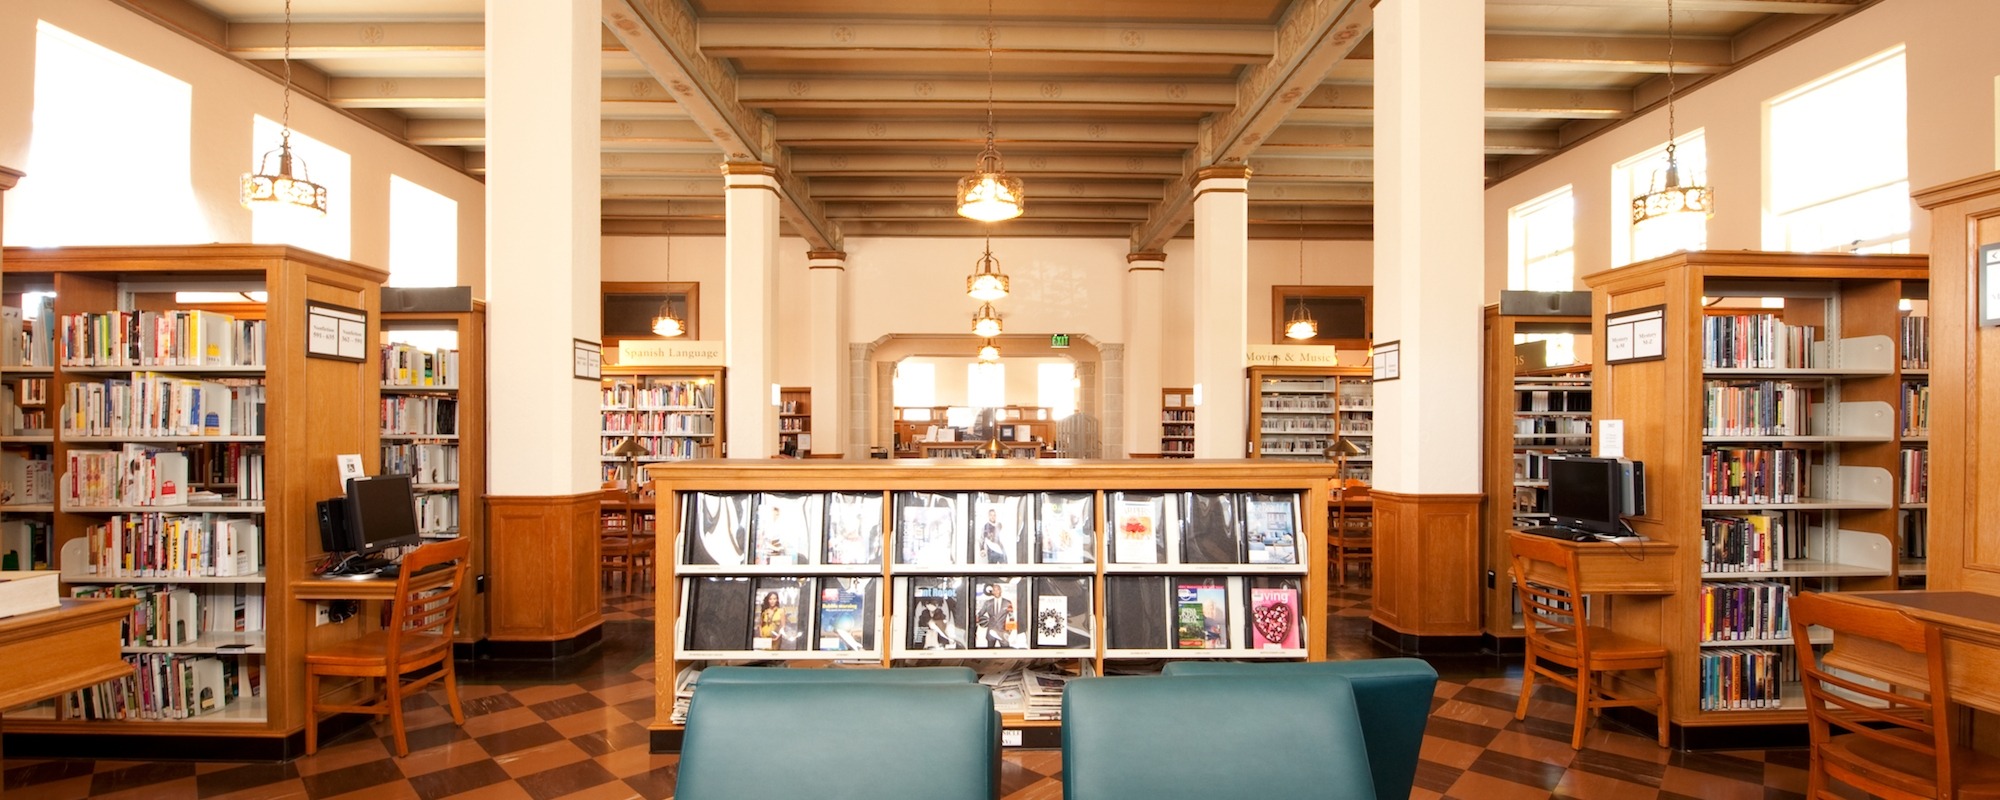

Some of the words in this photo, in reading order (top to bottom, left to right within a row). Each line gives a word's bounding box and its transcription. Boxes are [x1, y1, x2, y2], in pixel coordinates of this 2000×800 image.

[1052, 335, 1069, 347] EXIT
[624, 347, 665, 359] Spanish
[669, 347, 719, 359] Language
[1246, 352, 1281, 362] Movies
[1284, 353, 1295, 362] &
[1299, 352, 1331, 362] Music
